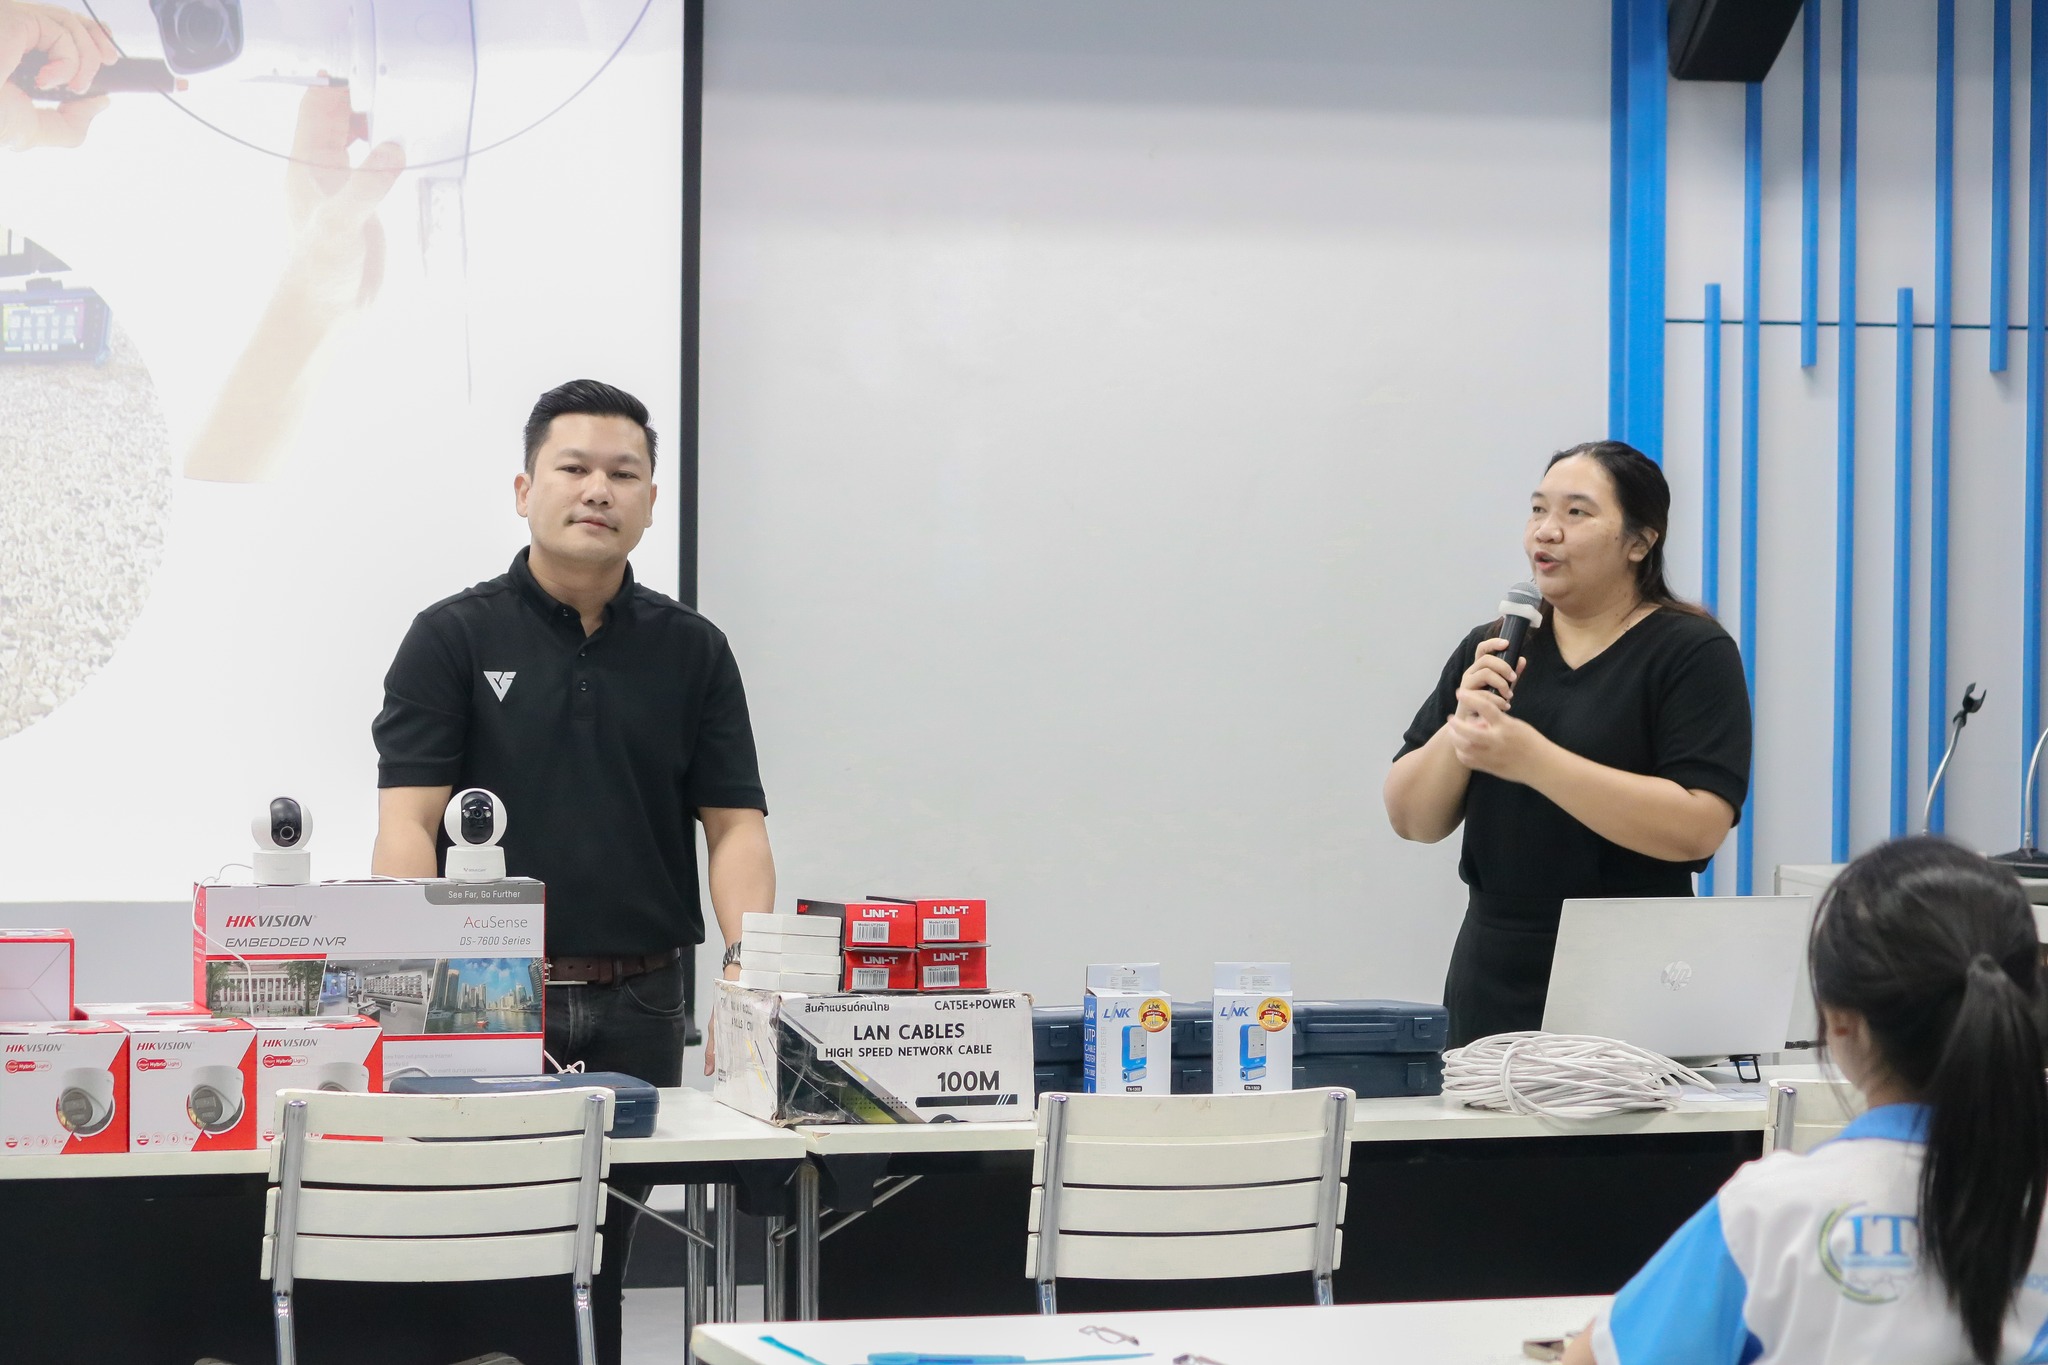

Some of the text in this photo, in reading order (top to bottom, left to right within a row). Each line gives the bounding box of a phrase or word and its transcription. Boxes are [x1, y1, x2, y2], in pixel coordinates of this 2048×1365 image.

[448, 890, 521, 899] See Far, Go Further
[862, 908, 898, 918] UNI-T
[933, 905, 969, 915] UNI-T
[225, 914, 313, 928] HIKVISION
[463, 915, 528, 929] AcuSense
[225, 936, 347, 948] EMBEDDED NVR
[460, 936, 531, 946] DS-7600 Series
[862, 956, 898, 965] UNI-T
[933, 952, 969, 962] UNI-T
[804, 1000, 890, 1013] สินค้าแบรนด์คนไทย
[934, 998, 1016, 1011] CAT5E+POWER
[853, 1023, 965, 1041] LAN CABLES
[1085, 1028, 1095, 1042] UTP
[5, 1043, 62, 1053] HIKVISION
[136, 1041, 192, 1051] HIKVISION
[262, 1039, 318, 1048] HIKVISION
[825, 1044, 992, 1058] HIGH SPEED NETWORK CABLE
[275, 1057, 292, 1065] Hybrid
[937, 1070, 1000, 1092] 100M
